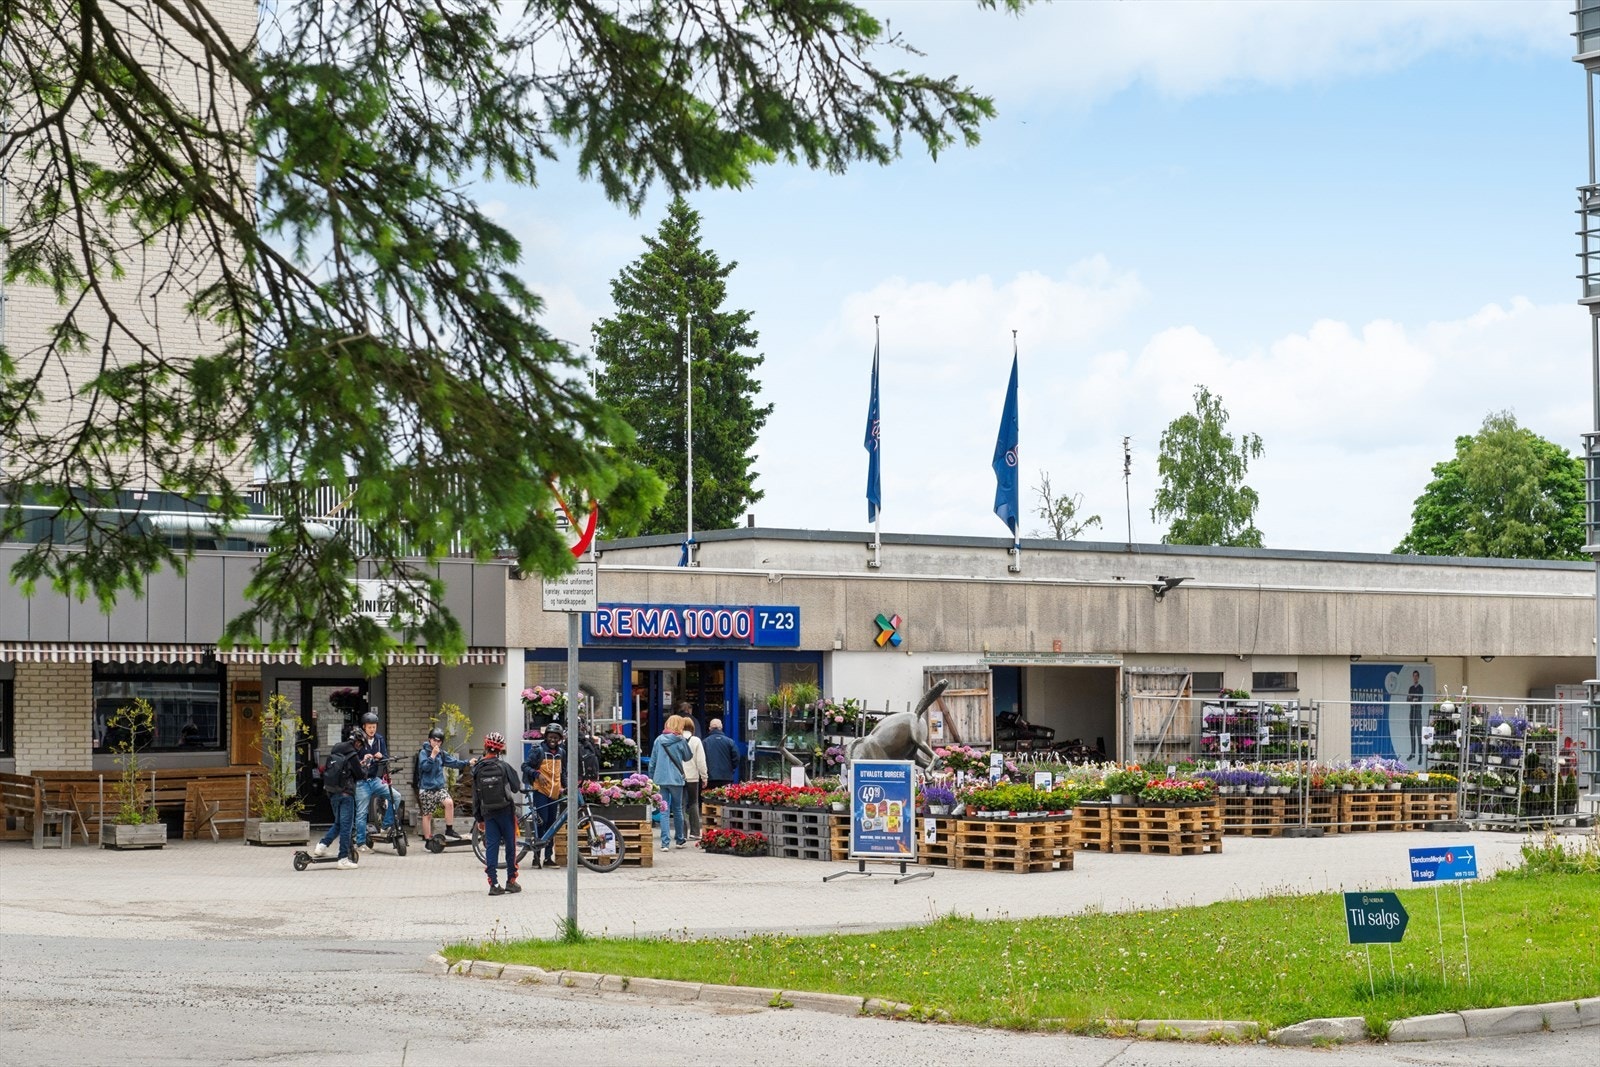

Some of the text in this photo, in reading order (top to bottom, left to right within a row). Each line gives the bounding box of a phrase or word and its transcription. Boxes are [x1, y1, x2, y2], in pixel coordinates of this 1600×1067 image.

[591, 608, 795, 639] REMA 1000 7-23
[860, 770, 882, 778] UTVALGTE
[1420, 870, 1435, 879] salgs
[1349, 908, 1400, 930] Til salgs
